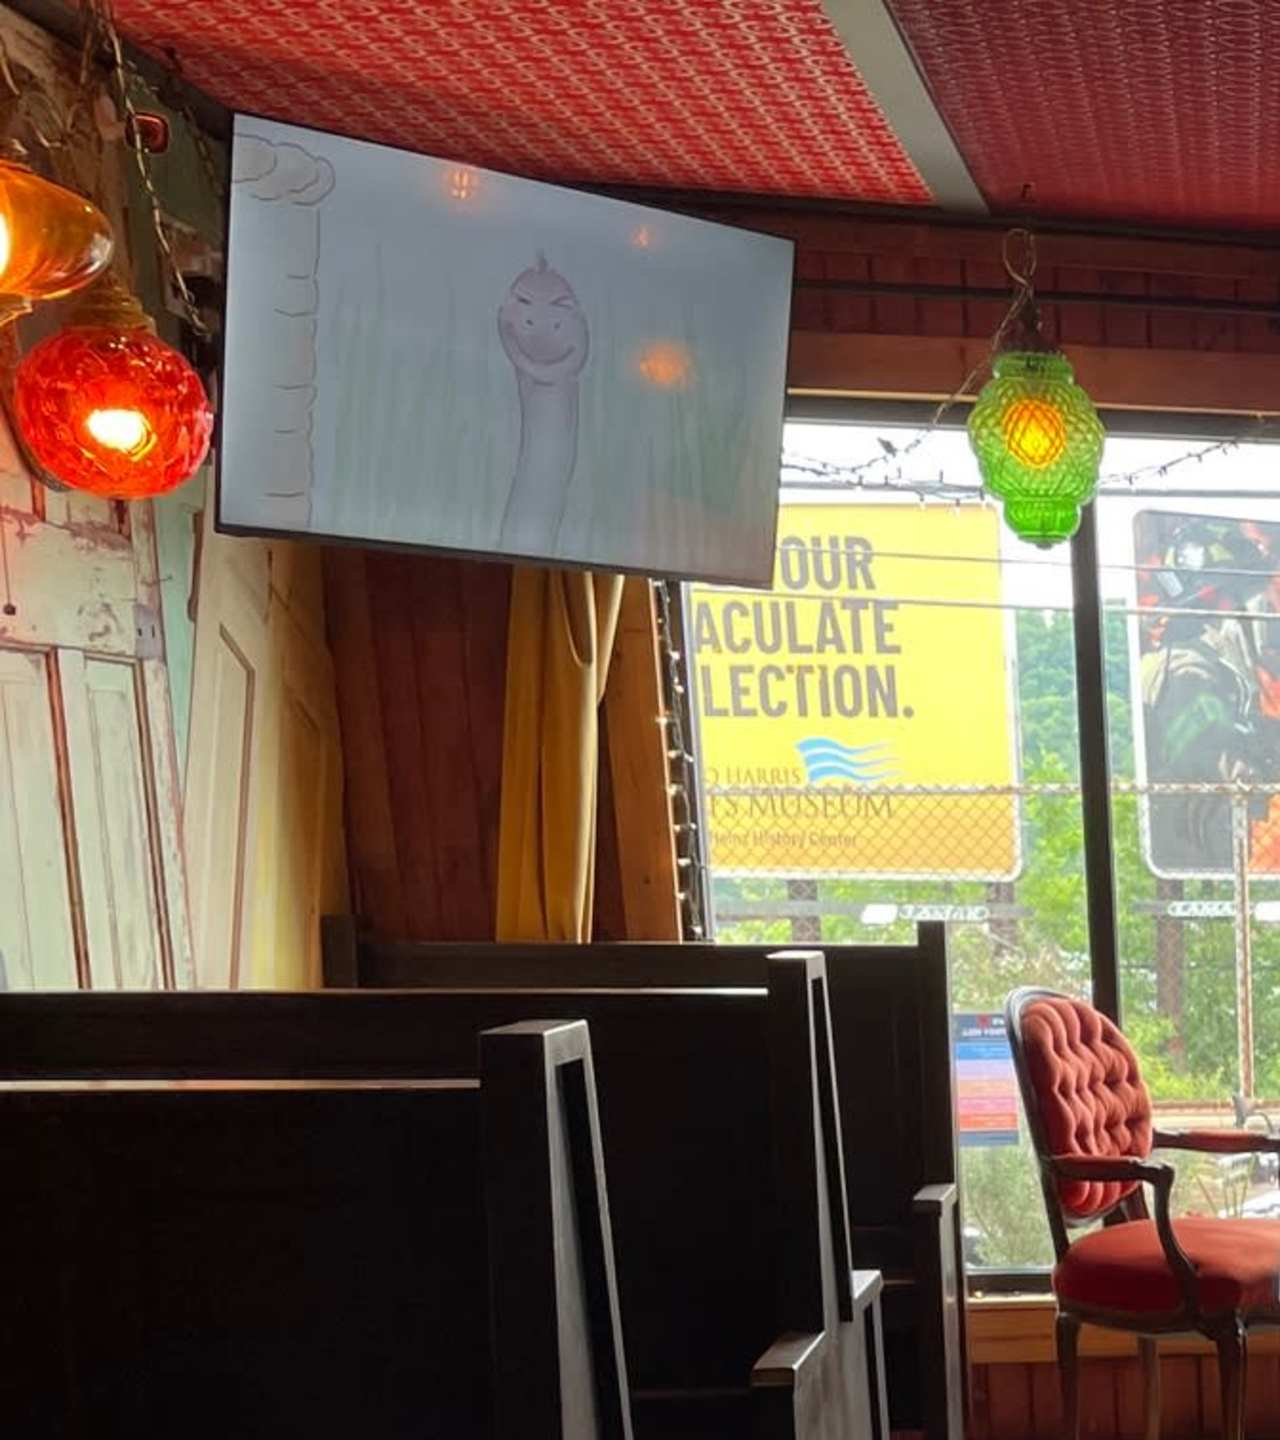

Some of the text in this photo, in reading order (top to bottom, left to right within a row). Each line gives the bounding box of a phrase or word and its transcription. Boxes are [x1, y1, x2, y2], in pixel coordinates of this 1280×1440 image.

[780, 535, 876, 592] OUR
[695, 597, 902, 655] ACULATE
[702, 664, 914, 719] LECTION.
[726, 767, 802, 785] HARRIS
[749, 793, 893, 819] MUSEUM
